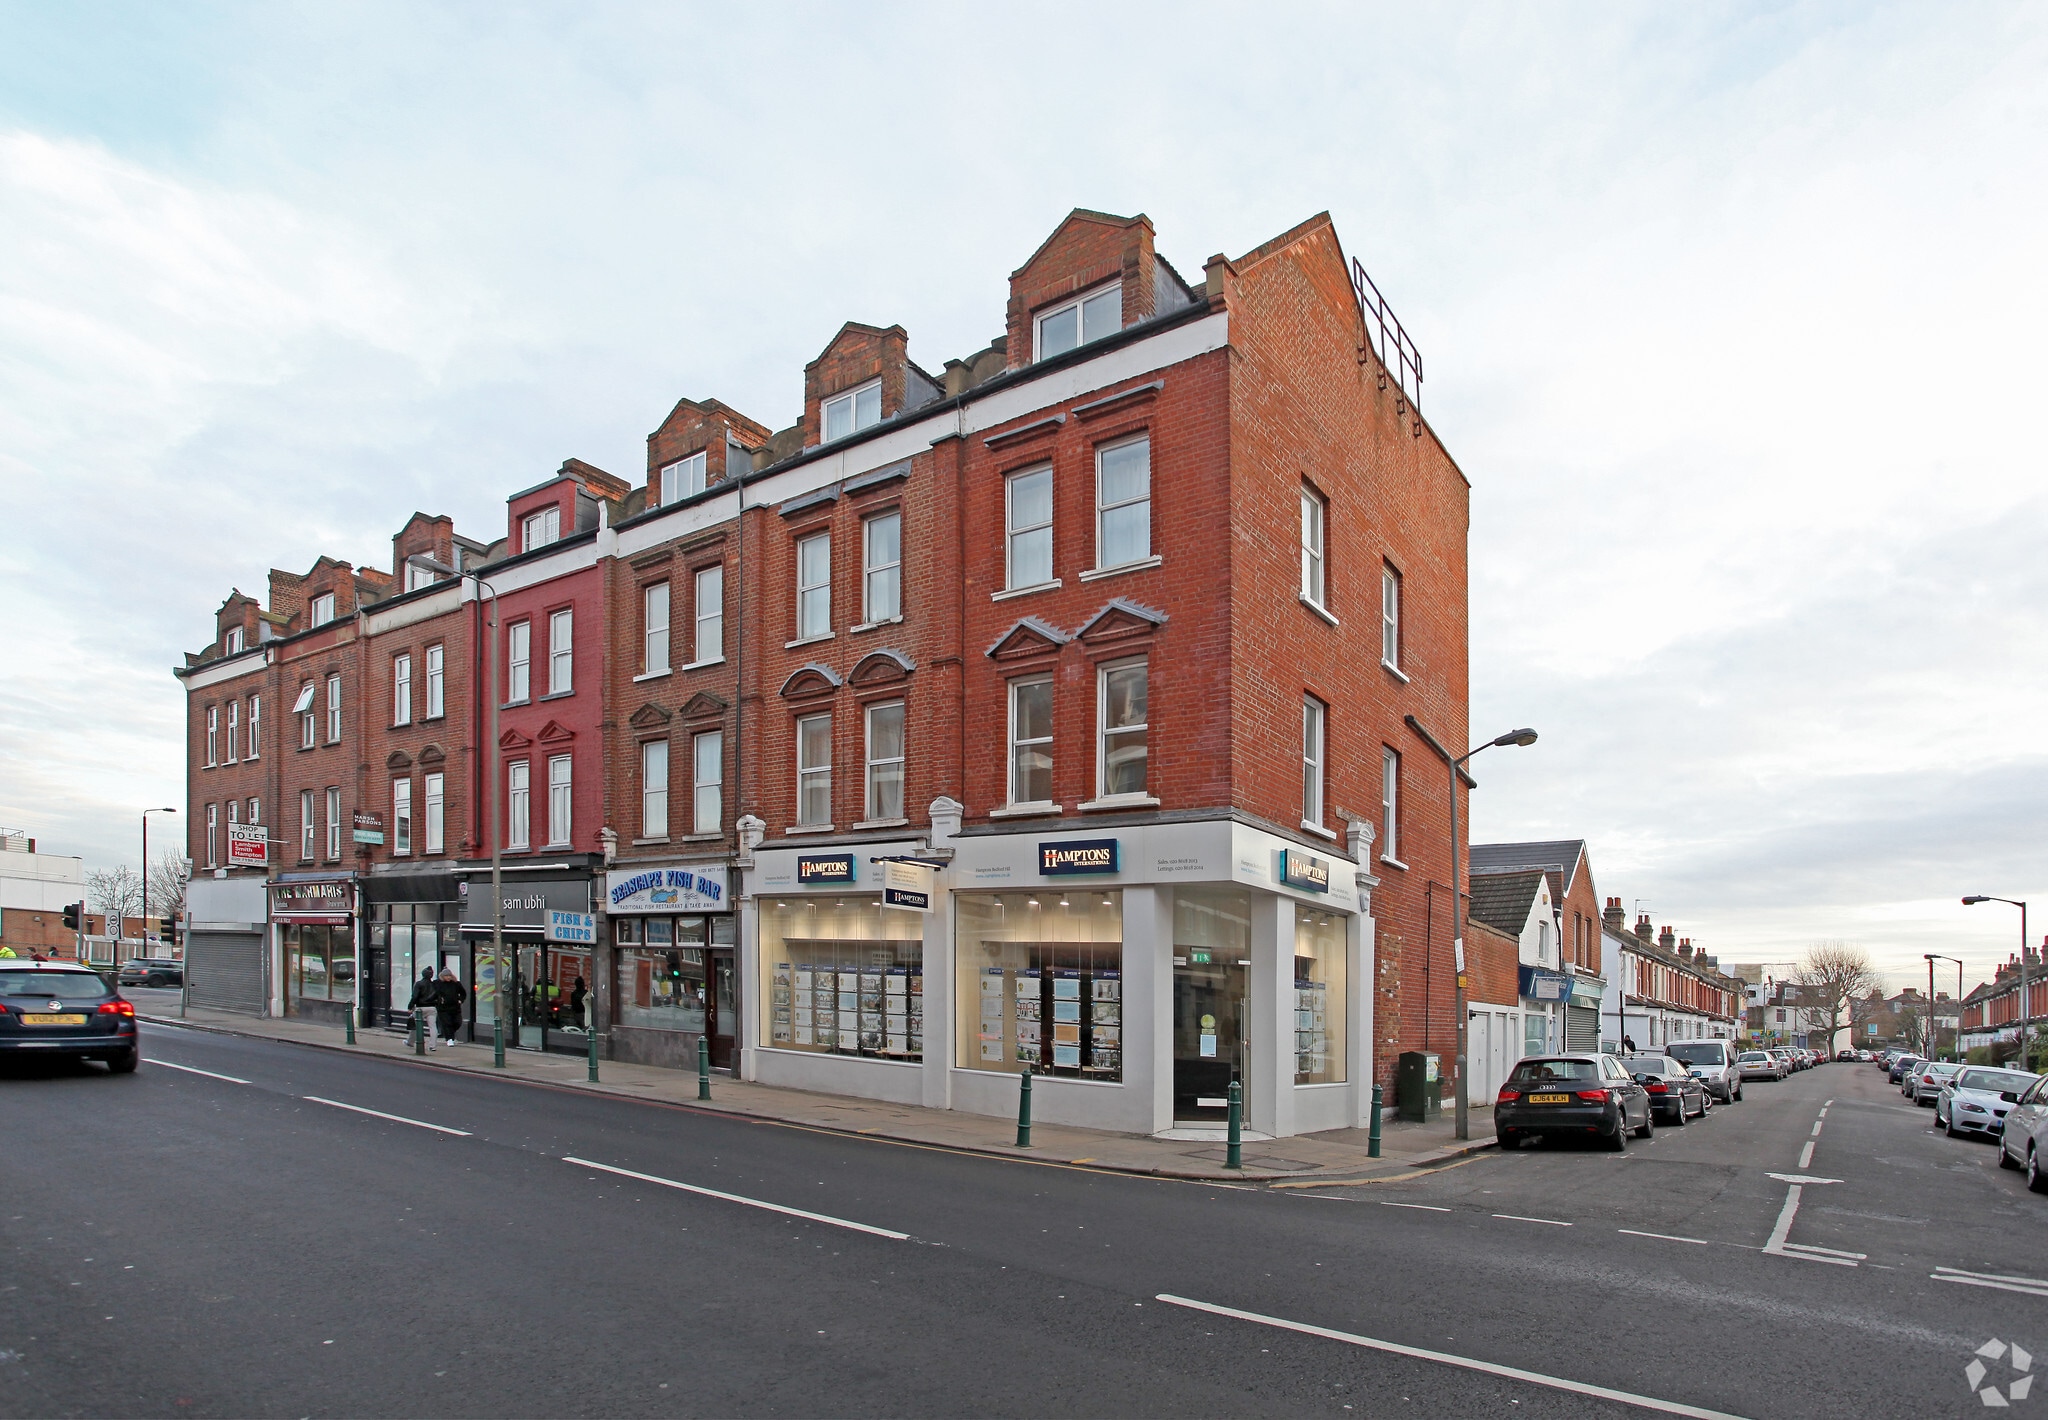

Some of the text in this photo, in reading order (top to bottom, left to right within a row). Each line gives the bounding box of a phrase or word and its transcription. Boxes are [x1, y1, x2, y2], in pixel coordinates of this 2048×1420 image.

[230, 831, 245, 840] TO
[234, 841, 261, 849] Lambert
[234, 851, 263, 859] Hampton
[1043, 848, 1110, 868] HAMPTONS
[801, 861, 848, 877] HAMPTONS
[1290, 857, 1327, 880] HAMPTONS
[611, 870, 721, 905] SEASCAPE FISH BAR
[503, 895, 545, 910] sam ubhi
[894, 891, 925, 903] HAMPTONS
[552, 911, 594, 927] FISH &
[555, 926, 591, 941] CHIPS
